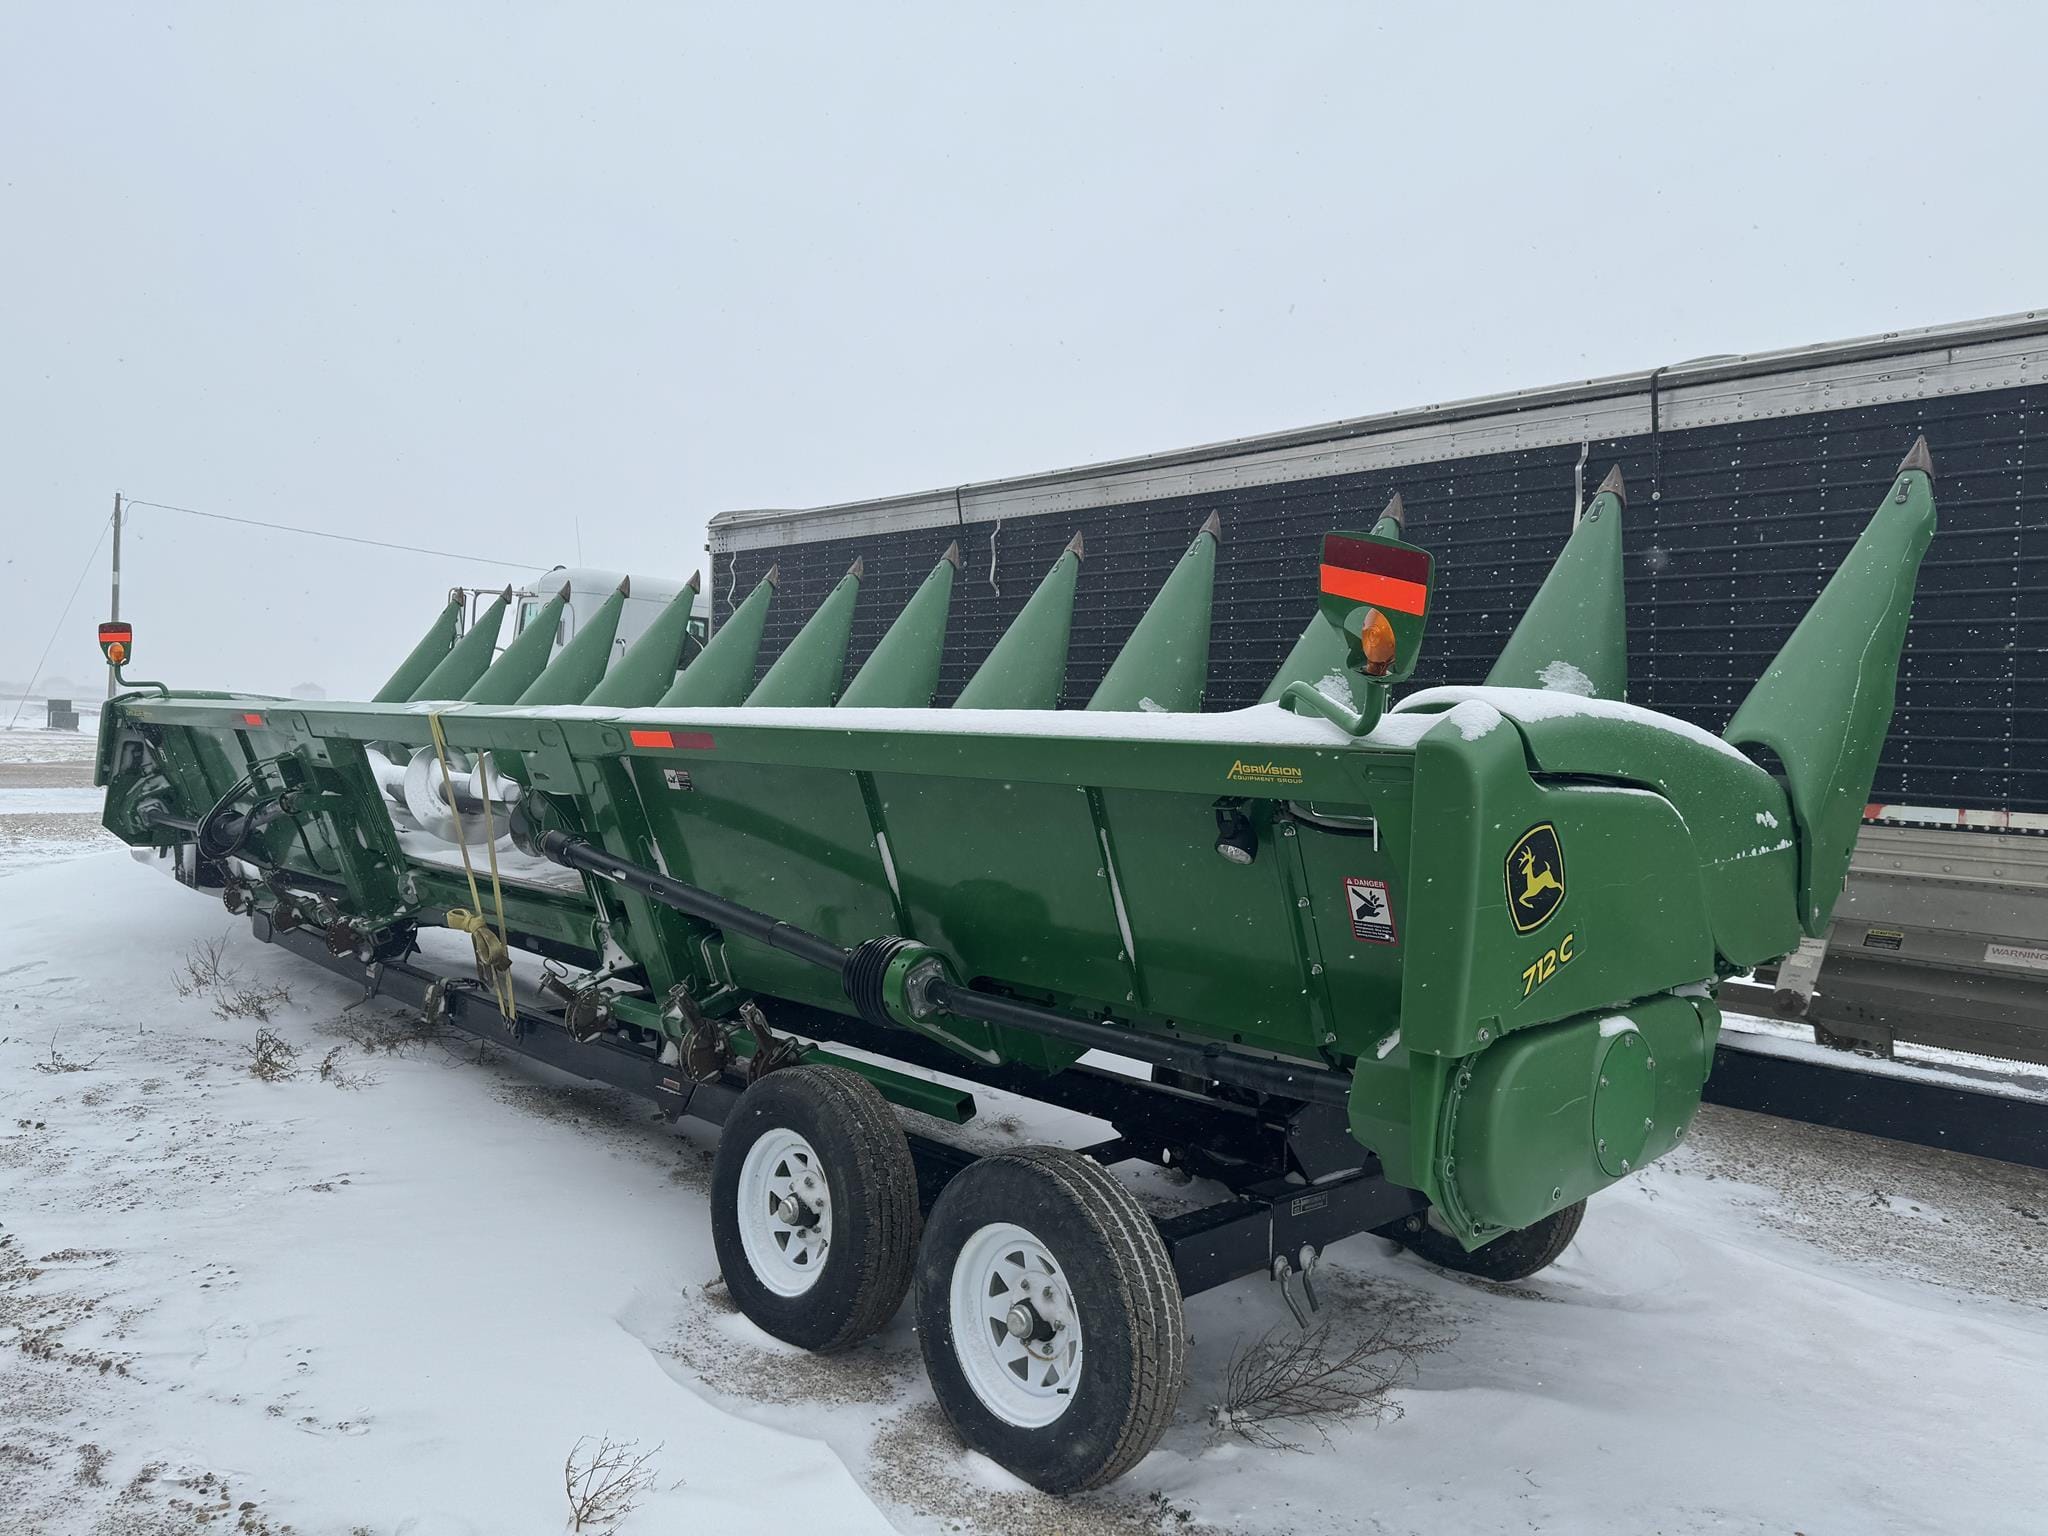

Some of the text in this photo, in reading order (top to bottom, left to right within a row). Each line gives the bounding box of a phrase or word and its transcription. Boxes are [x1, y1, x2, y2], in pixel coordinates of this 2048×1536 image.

[1233, 774, 1274, 782] EQUIPMENT
[1354, 878, 1385, 888] DANGER
[1991, 946, 2048, 961] WARNING
